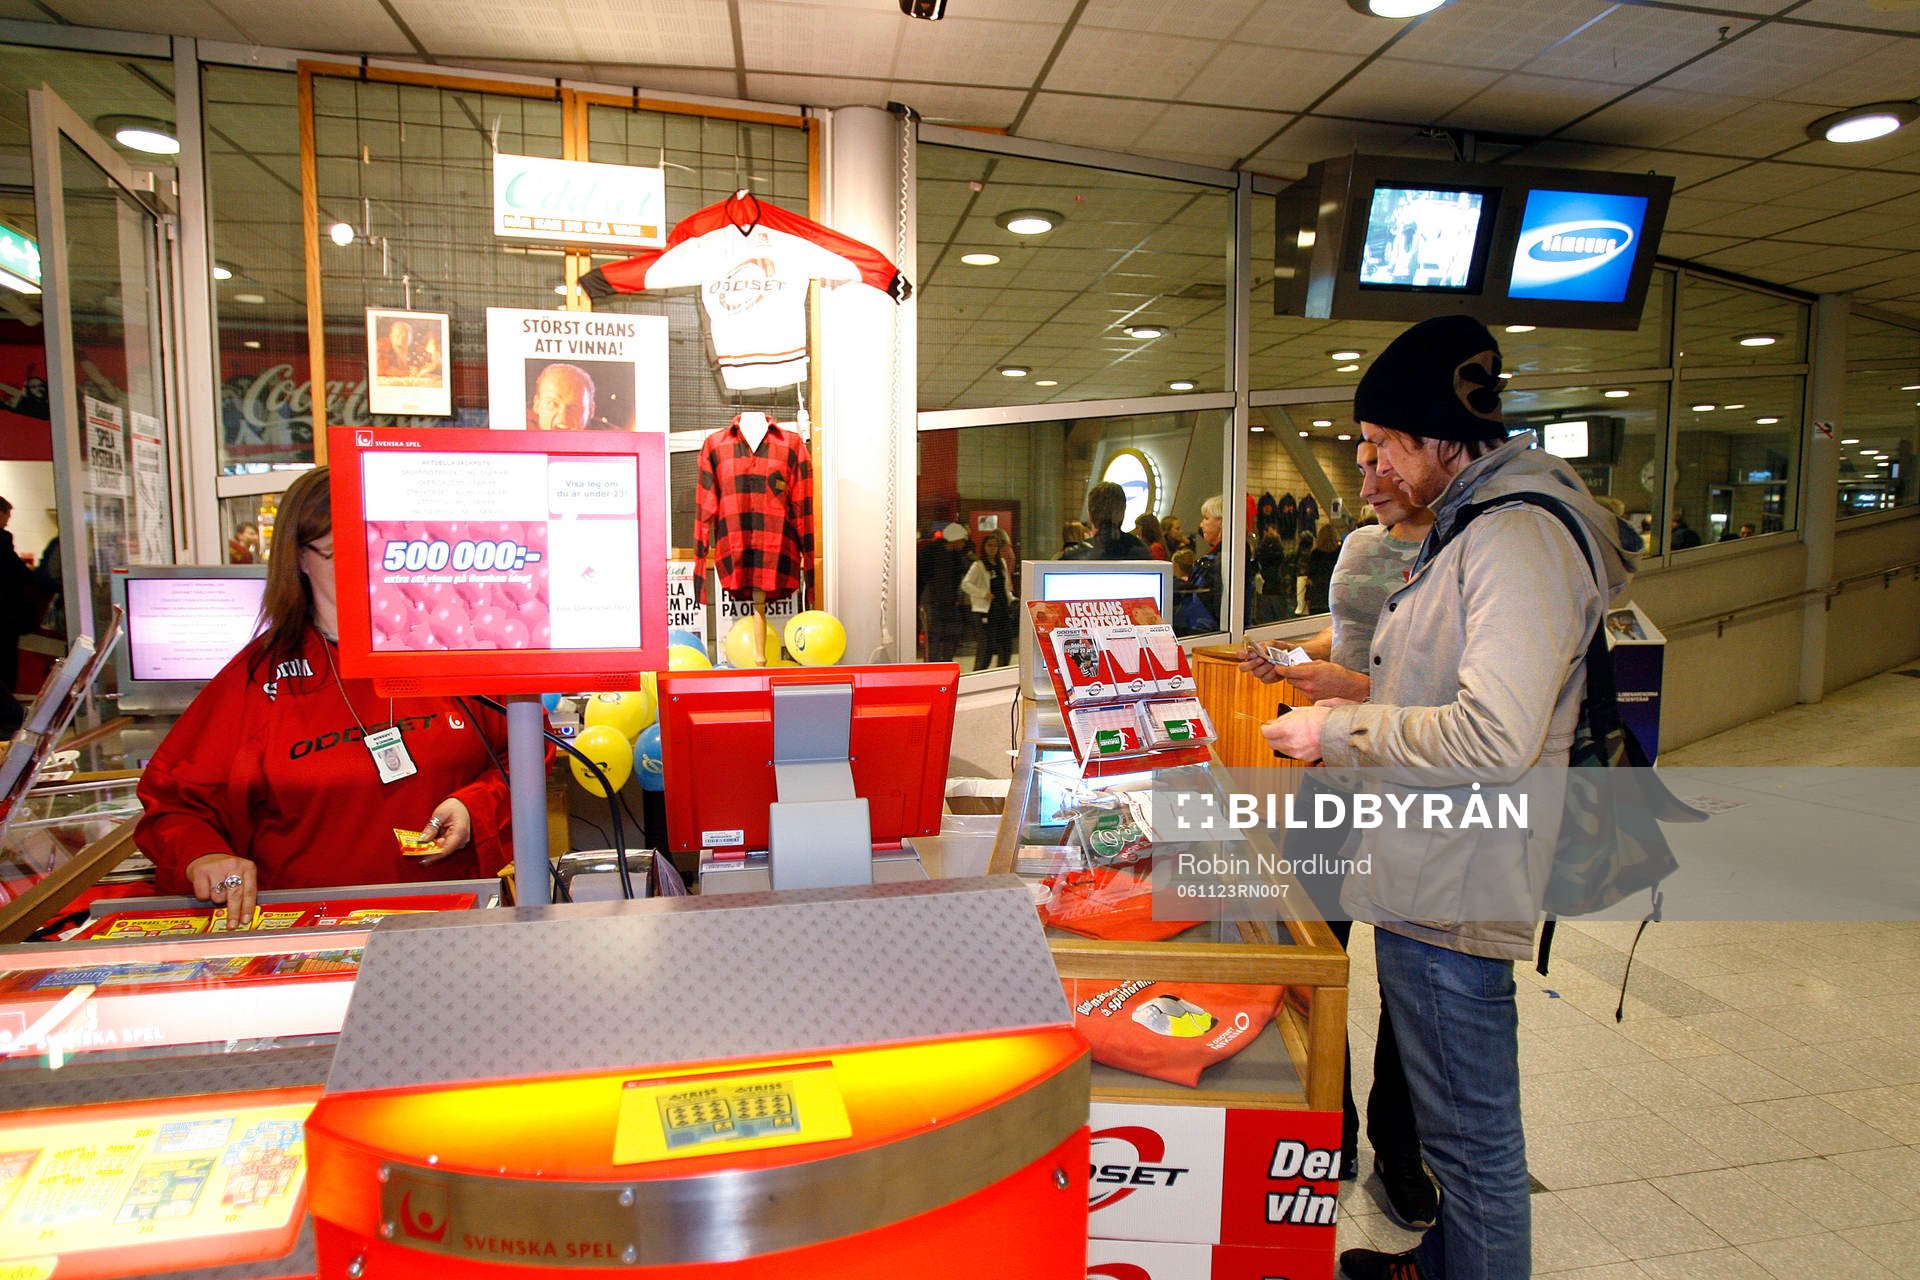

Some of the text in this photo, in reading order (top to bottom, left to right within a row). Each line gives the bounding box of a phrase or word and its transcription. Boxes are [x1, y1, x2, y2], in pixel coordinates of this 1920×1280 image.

[1541, 236, 1617, 254] SAMSUNG
[523, 315, 636, 338] STÖRST CHANS
[535, 339, 624, 356] ATT VINNA!
[565, 480, 585, 488] Visa
[382, 540, 542, 572] 500 000:-
[1065, 601, 1124, 617] VECKANS
[683, 1083, 783, 1100] TRISS TRISS
[1090, 1164, 1189, 1186] SET
[1266, 1187, 1338, 1225] vin
[463, 1233, 617, 1258] SVENSKA SPEL
